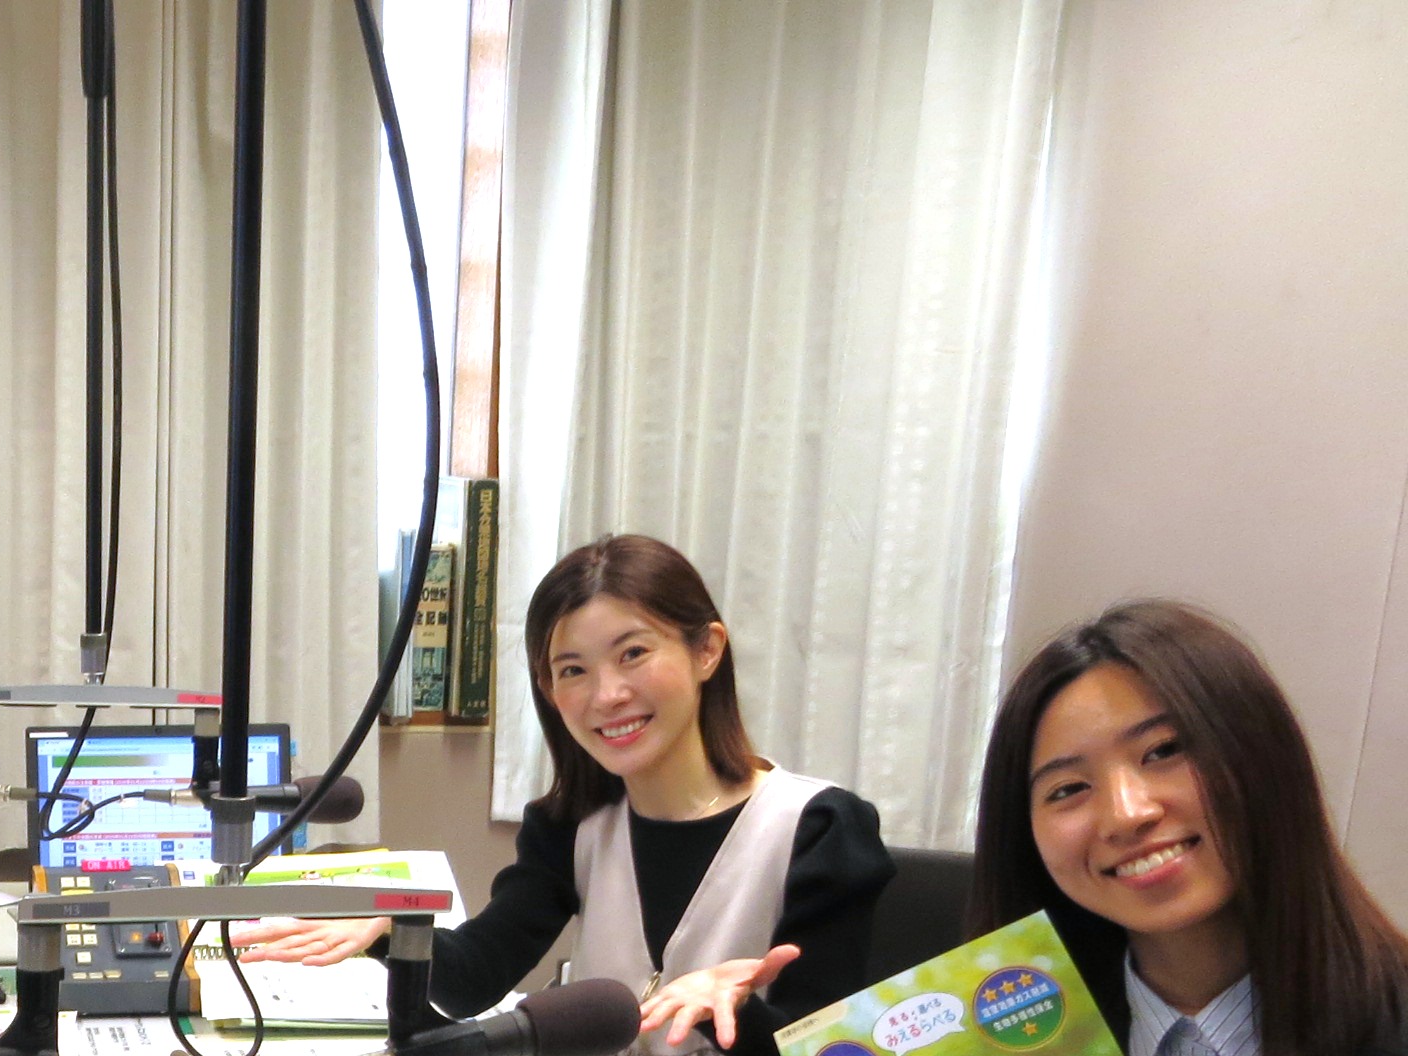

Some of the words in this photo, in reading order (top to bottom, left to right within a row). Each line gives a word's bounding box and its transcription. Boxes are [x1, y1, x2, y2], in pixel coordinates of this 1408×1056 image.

[87, 860, 101, 870] ON
[106, 860, 125, 870] AIR
[63, 904, 80, 916] M3
[884, 1010, 957, 1048] みえるらべる
